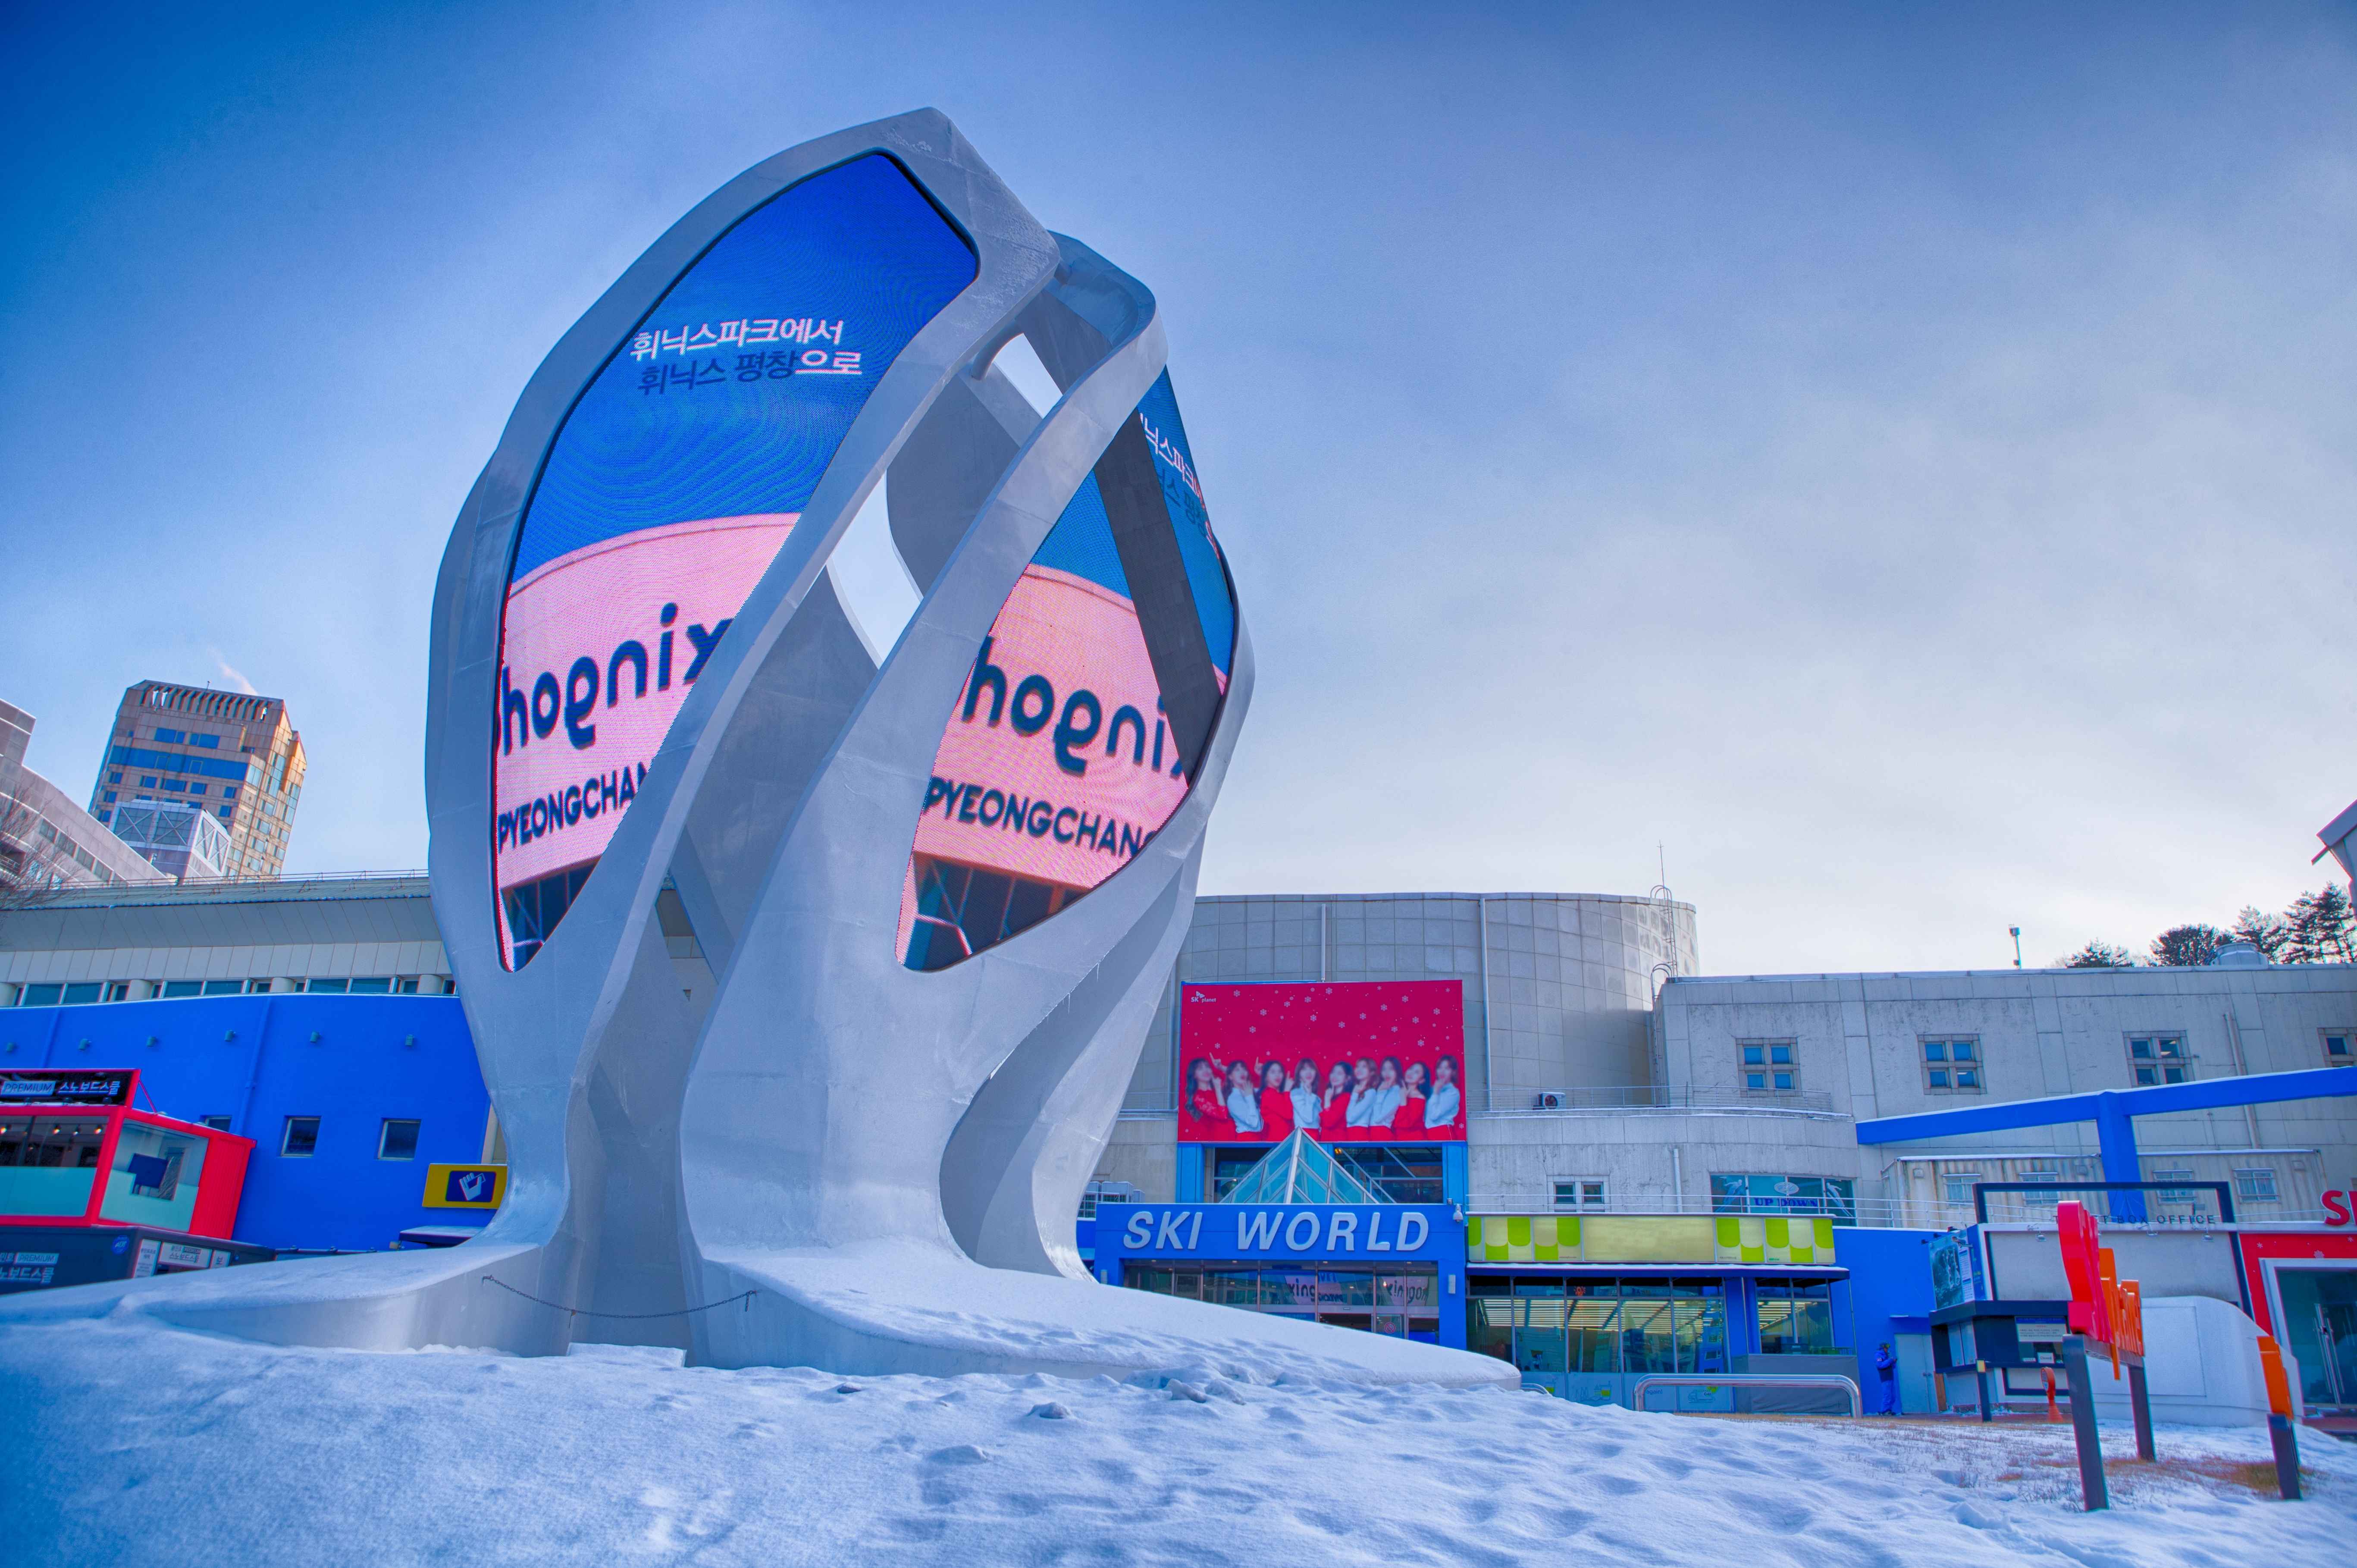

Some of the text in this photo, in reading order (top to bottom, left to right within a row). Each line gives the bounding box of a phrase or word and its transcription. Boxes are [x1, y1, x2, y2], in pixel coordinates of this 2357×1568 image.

[630, 318, 844, 361] 휘닉스파크에서
[638, 349, 862, 395] 휘닉스 평창으로
[961, 636, 1183, 777] hoeni
[923, 777, 1157, 857] PYEONGCHAN
[5, 1081, 120, 1094] PREMIUM 스노보드스쿨
[1754, 1198, 1818, 1207] UP DOWN
[2118, 1215, 2147, 1224] BOX
[2156, 1215, 2216, 1224] OFFICE
[1123, 1211, 1429, 1251] SKI WORLD
